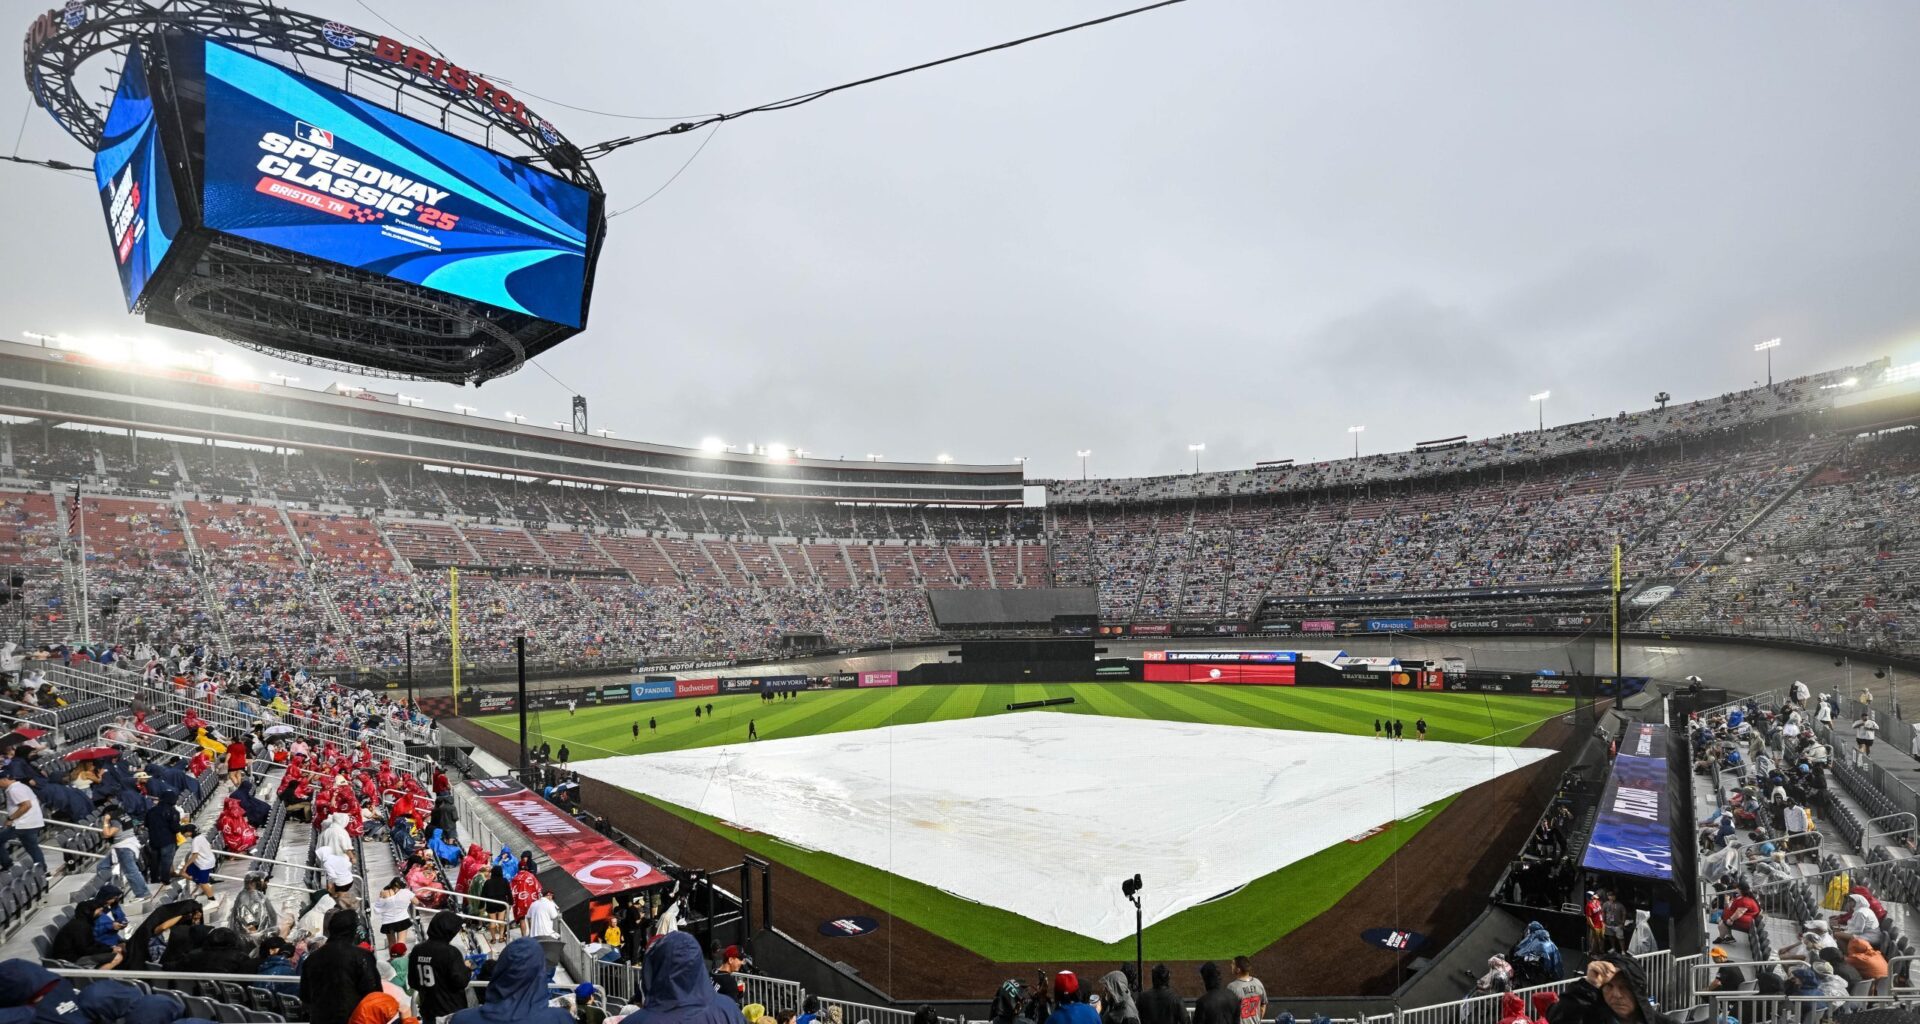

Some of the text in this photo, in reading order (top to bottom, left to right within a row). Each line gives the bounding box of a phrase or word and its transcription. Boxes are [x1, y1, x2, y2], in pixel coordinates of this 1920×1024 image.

[374, 35, 530, 127] BRISTOL
[258, 132, 449, 206] SPEEDWAY
[256, 154, 415, 216] CLASSIC
[269, 183, 344, 212] BRISTOL, TN
[394, 218, 425, 231] Presented
[639, 660, 730, 673] BRISTOL MOTOR SPEEDWAY
[645, 686, 672, 694] FANDUEL
[678, 684, 715, 693] Budweiser
[417, 964, 436, 987] 19
[1241, 995, 1261, 1019] 27
